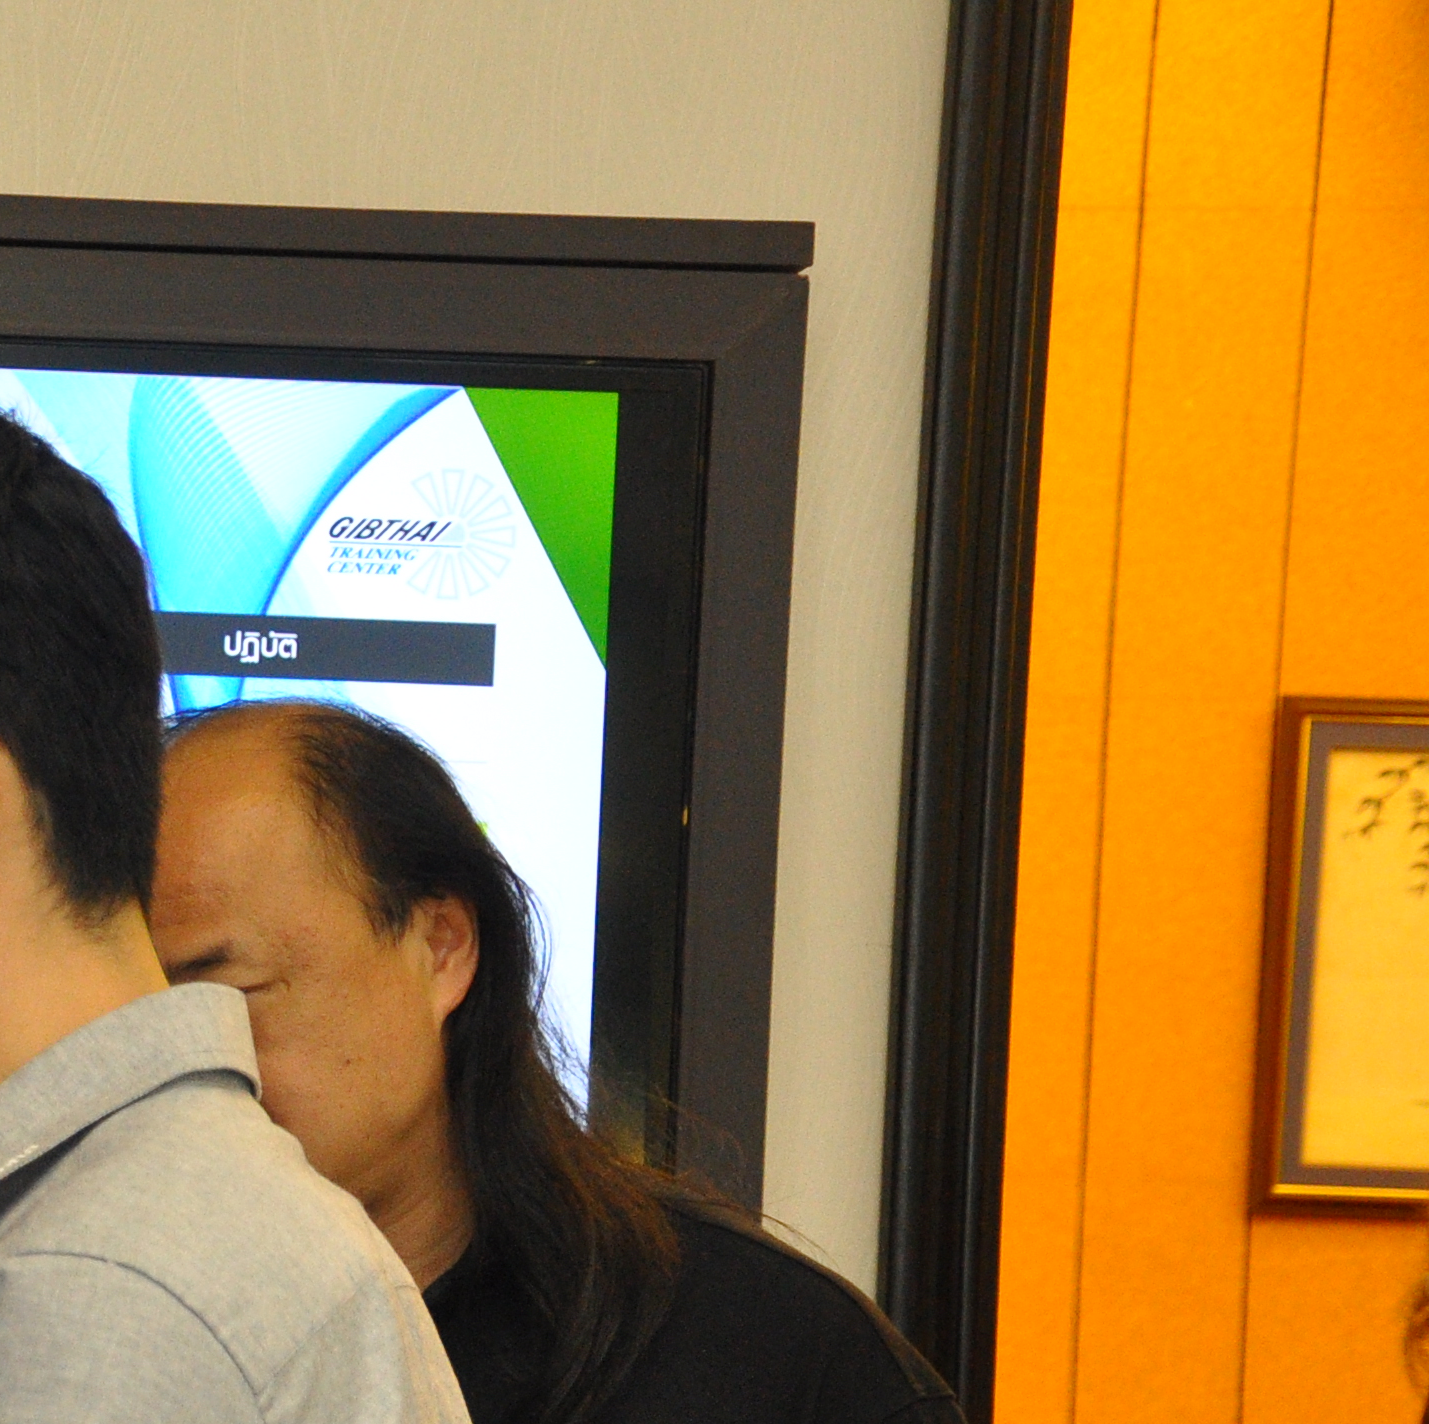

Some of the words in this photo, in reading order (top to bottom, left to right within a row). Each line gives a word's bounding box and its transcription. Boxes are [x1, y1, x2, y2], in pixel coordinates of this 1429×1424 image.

[329, 517, 452, 542] GIBTHAI
[329, 546, 418, 562] TRAINING
[327, 561, 401, 575] CENTER
